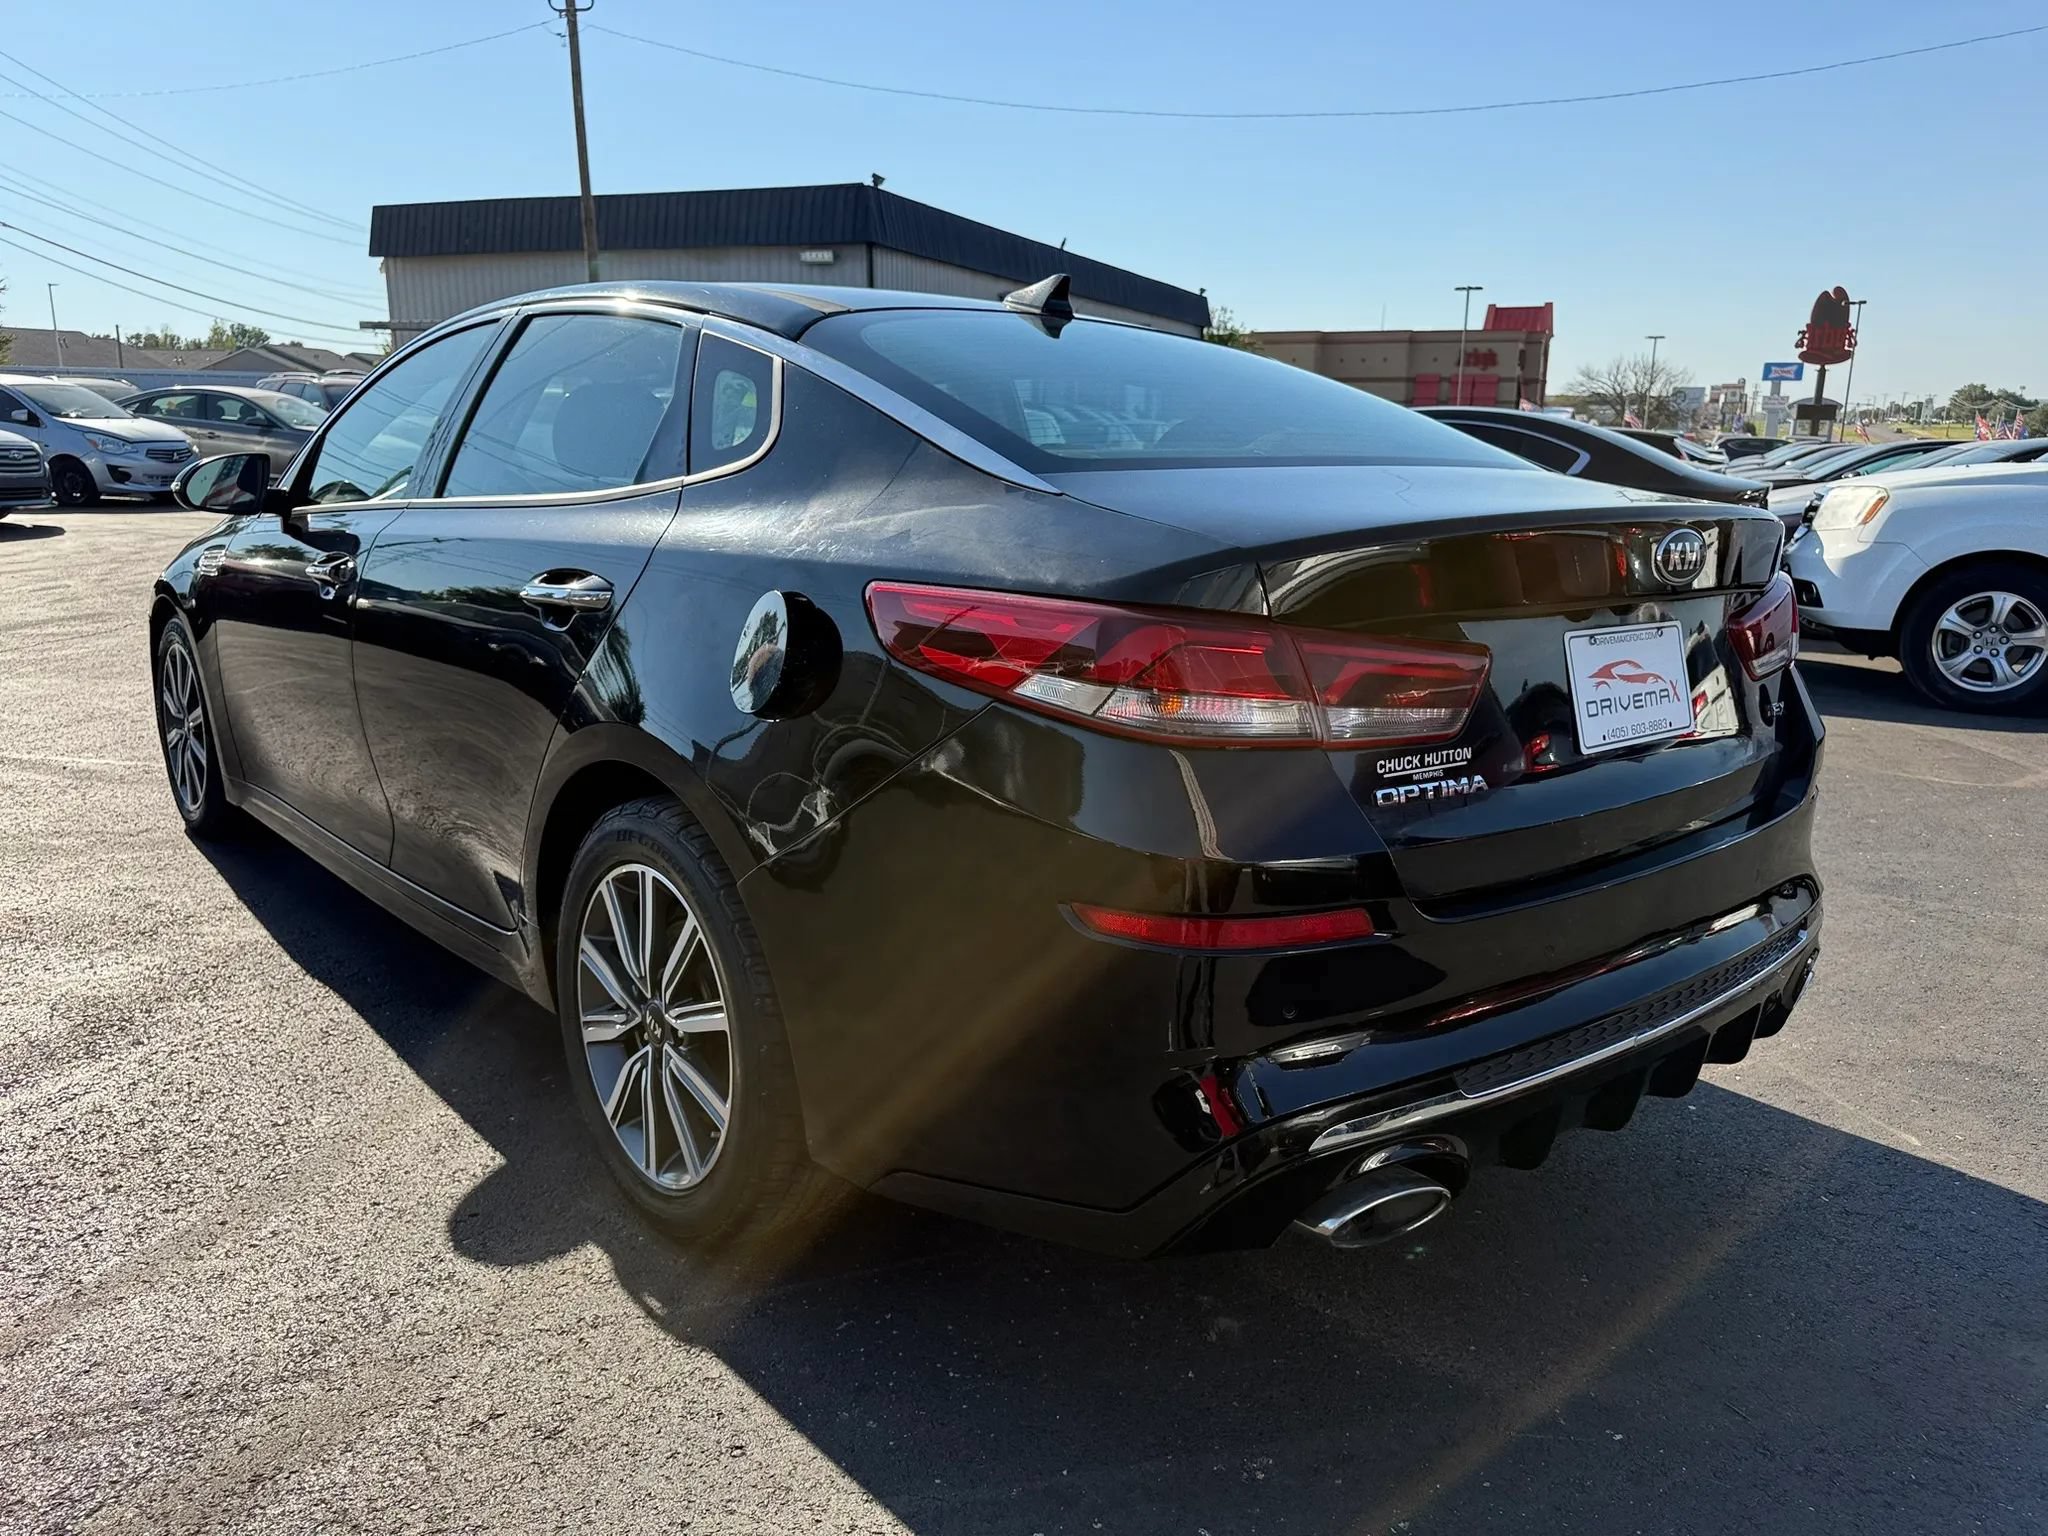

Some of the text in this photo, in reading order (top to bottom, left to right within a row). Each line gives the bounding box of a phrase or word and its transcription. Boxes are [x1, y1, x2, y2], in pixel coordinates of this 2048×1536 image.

[1667, 541, 1701, 571] KIA
[1585, 679, 1681, 718] DRIVEMAX
[1606, 718, 1668, 740] (405) 603-8883
[1376, 746, 1472, 774] CHUCK HUTTON
[1412, 769, 1444, 781] MEMPHIS
[1375, 774, 1489, 807] OPTIMA
[646, 1009, 662, 1039] KIA
